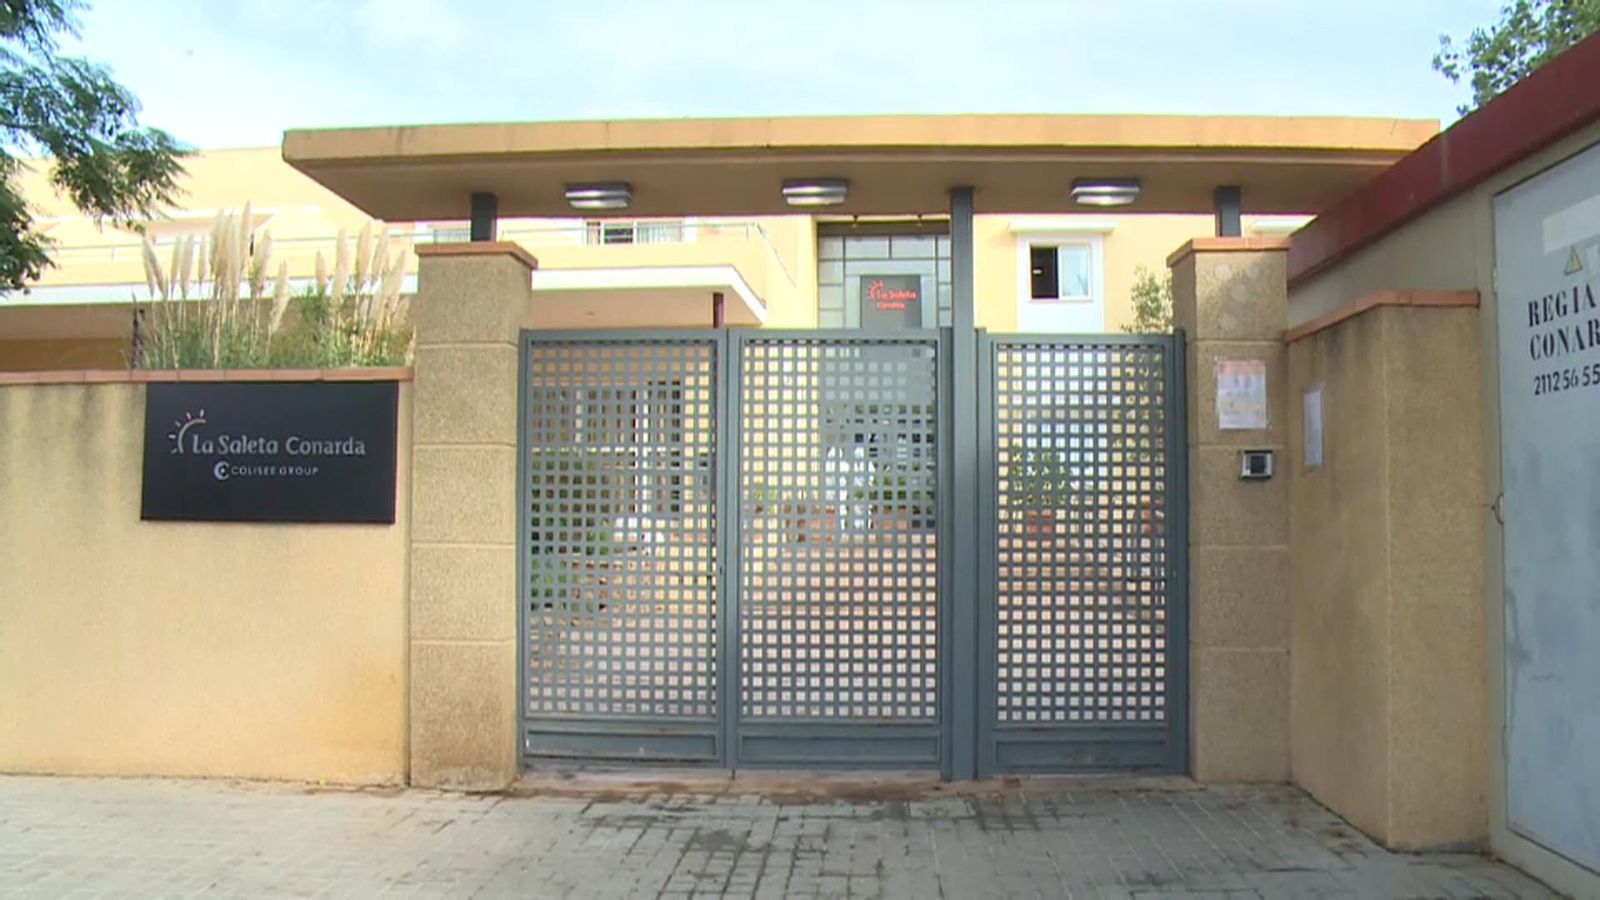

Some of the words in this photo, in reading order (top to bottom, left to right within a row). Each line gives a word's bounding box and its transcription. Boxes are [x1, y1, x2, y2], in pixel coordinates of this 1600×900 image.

[192, 434, 214, 454] La
[217, 434, 279, 455] Saleta
[285, 436, 366, 456] Conarda
[279, 465, 319, 476] GROUP
